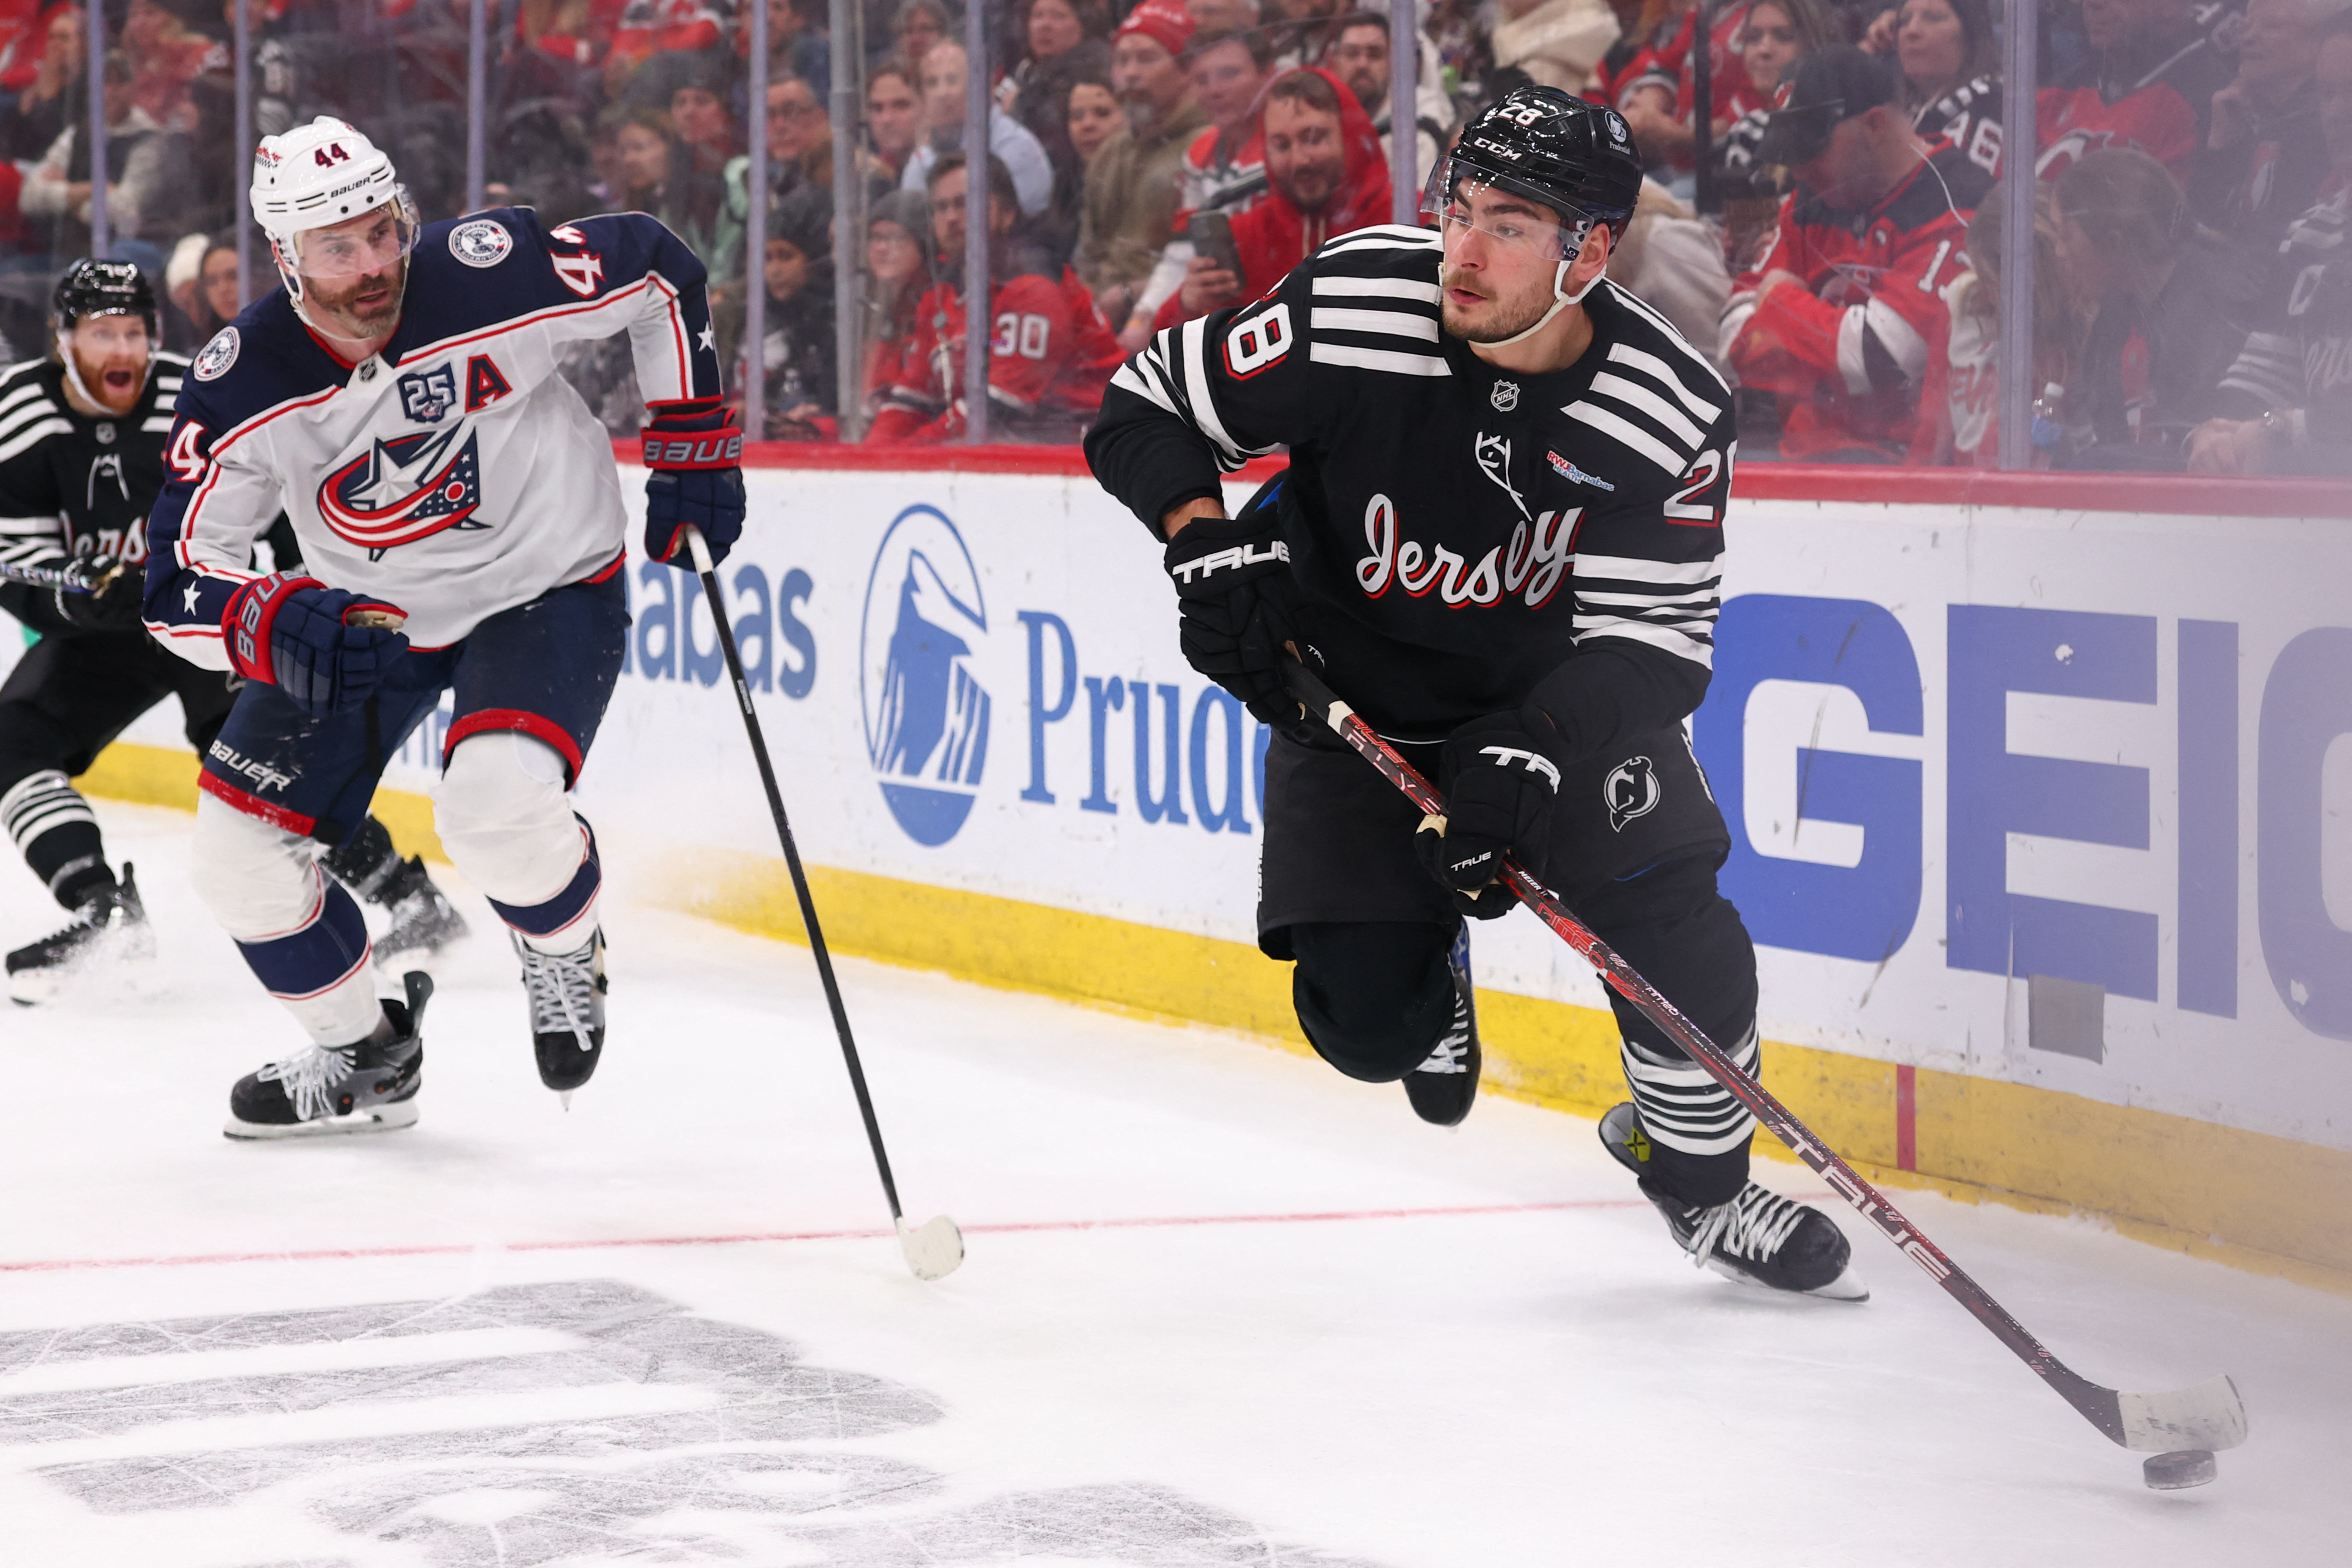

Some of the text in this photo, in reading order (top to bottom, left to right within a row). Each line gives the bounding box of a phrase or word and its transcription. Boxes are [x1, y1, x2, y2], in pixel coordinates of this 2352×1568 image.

[1498, 102, 1544, 127] 28
[315, 142, 350, 168] 44
[1474, 136, 1522, 161] CCM
[330, 177, 370, 198] BAUER
[993, 312, 1050, 360] 30
[404, 374, 452, 414] 25
[465, 353, 513, 414] A
[1496, 390, 1514, 403] NHL
[1547, 451, 1615, 491] RWJBarnabas
[1553, 464, 1582, 484] HEALTH
[1663, 440, 1738, 527] 2
[1172, 540, 1291, 584] TRUE
[209, 739, 292, 792] BAUER
[1450, 851, 1492, 872] TRUE
[1518, 870, 1542, 891] MEIER
[1779, 1122, 1952, 1283] TRUE
